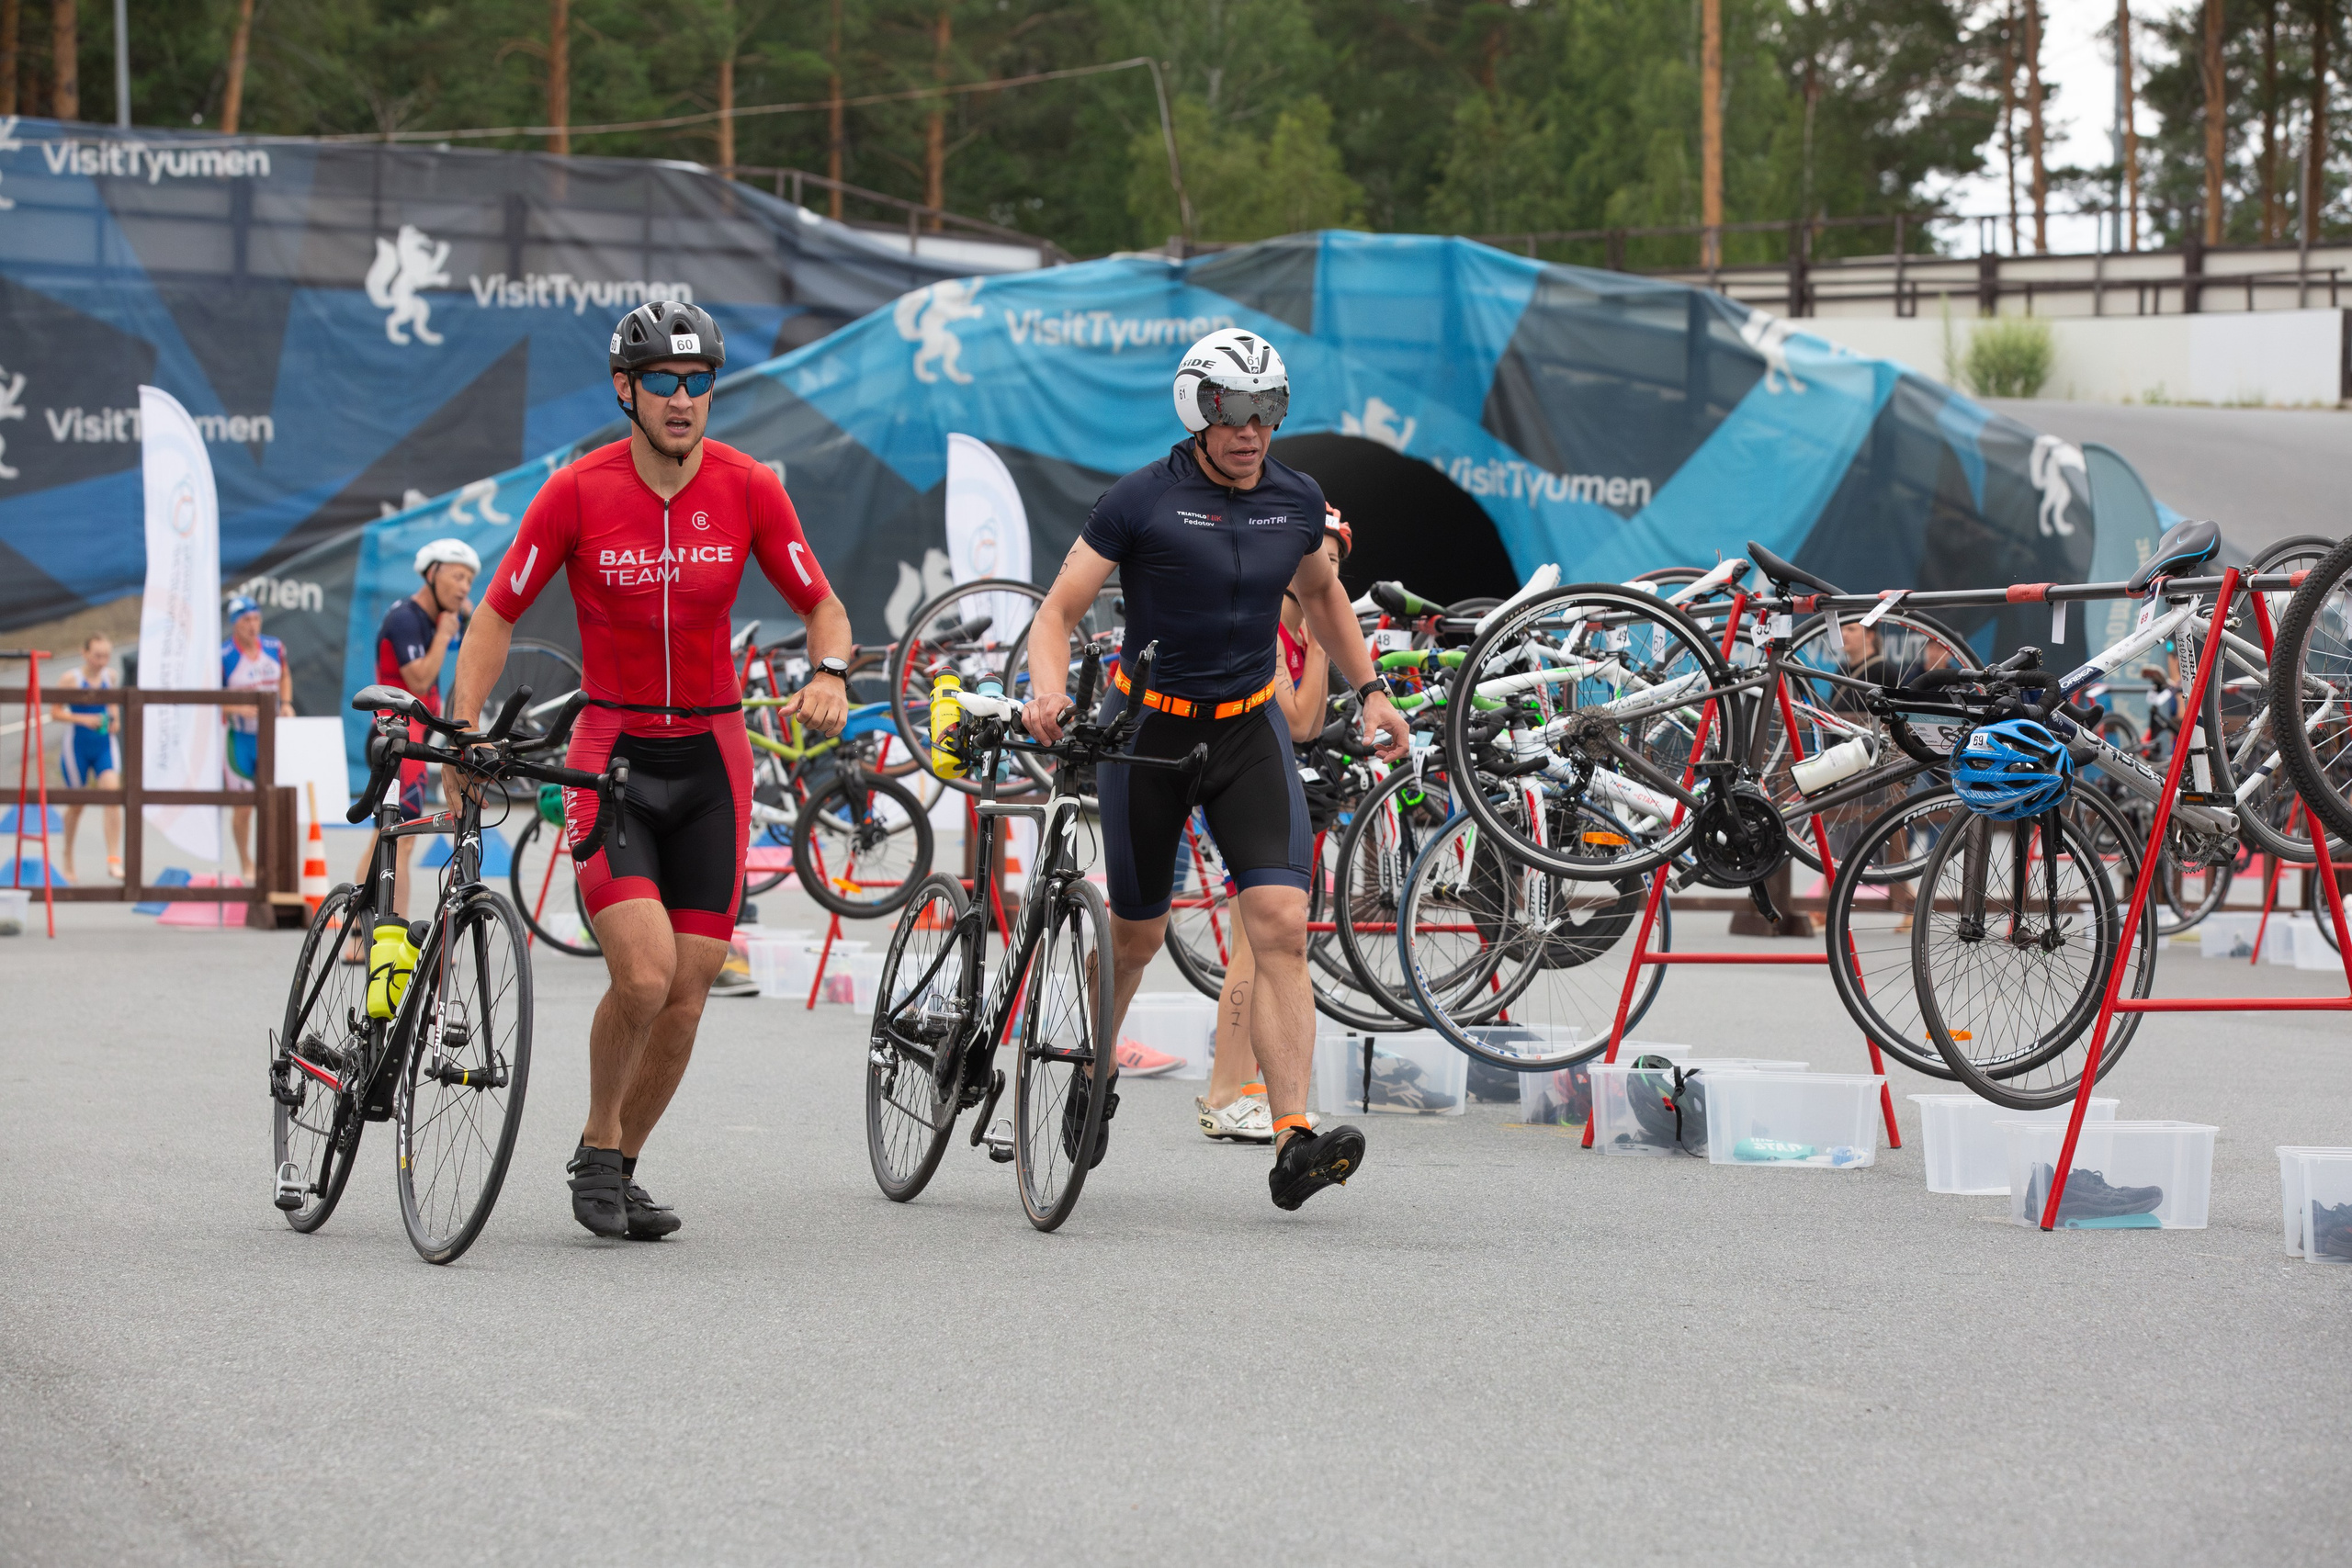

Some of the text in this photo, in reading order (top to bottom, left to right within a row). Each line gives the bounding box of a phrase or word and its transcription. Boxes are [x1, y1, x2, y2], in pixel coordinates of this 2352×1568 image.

[42, 140, 272, 186] VisitTyumen
[469, 273, 694, 317] VisitTyumen
[676, 339, 694, 351] 60
[1247, 355, 1261, 367] 61
[1179, 388, 1186, 400] 61
[46, 408, 275, 445] VisitTmen
[1183, 518, 1215, 527] Fedotov
[599, 546, 733, 567] BALANCE
[599, 566, 680, 586] TEAM
[1504, 604, 1531, 624] KENDA
[2140, 611, 2150, 626] 69
[1376, 634, 1391, 646] 48
[1479, 599, 1574, 671] nameless
[1616, 630, 1628, 643] 49
[1653, 635, 1665, 652] 67
[2060, 666, 2094, 689] ORBEA
[1973, 735, 1984, 747] 69
[433, 1001, 447, 1057] KEMO
